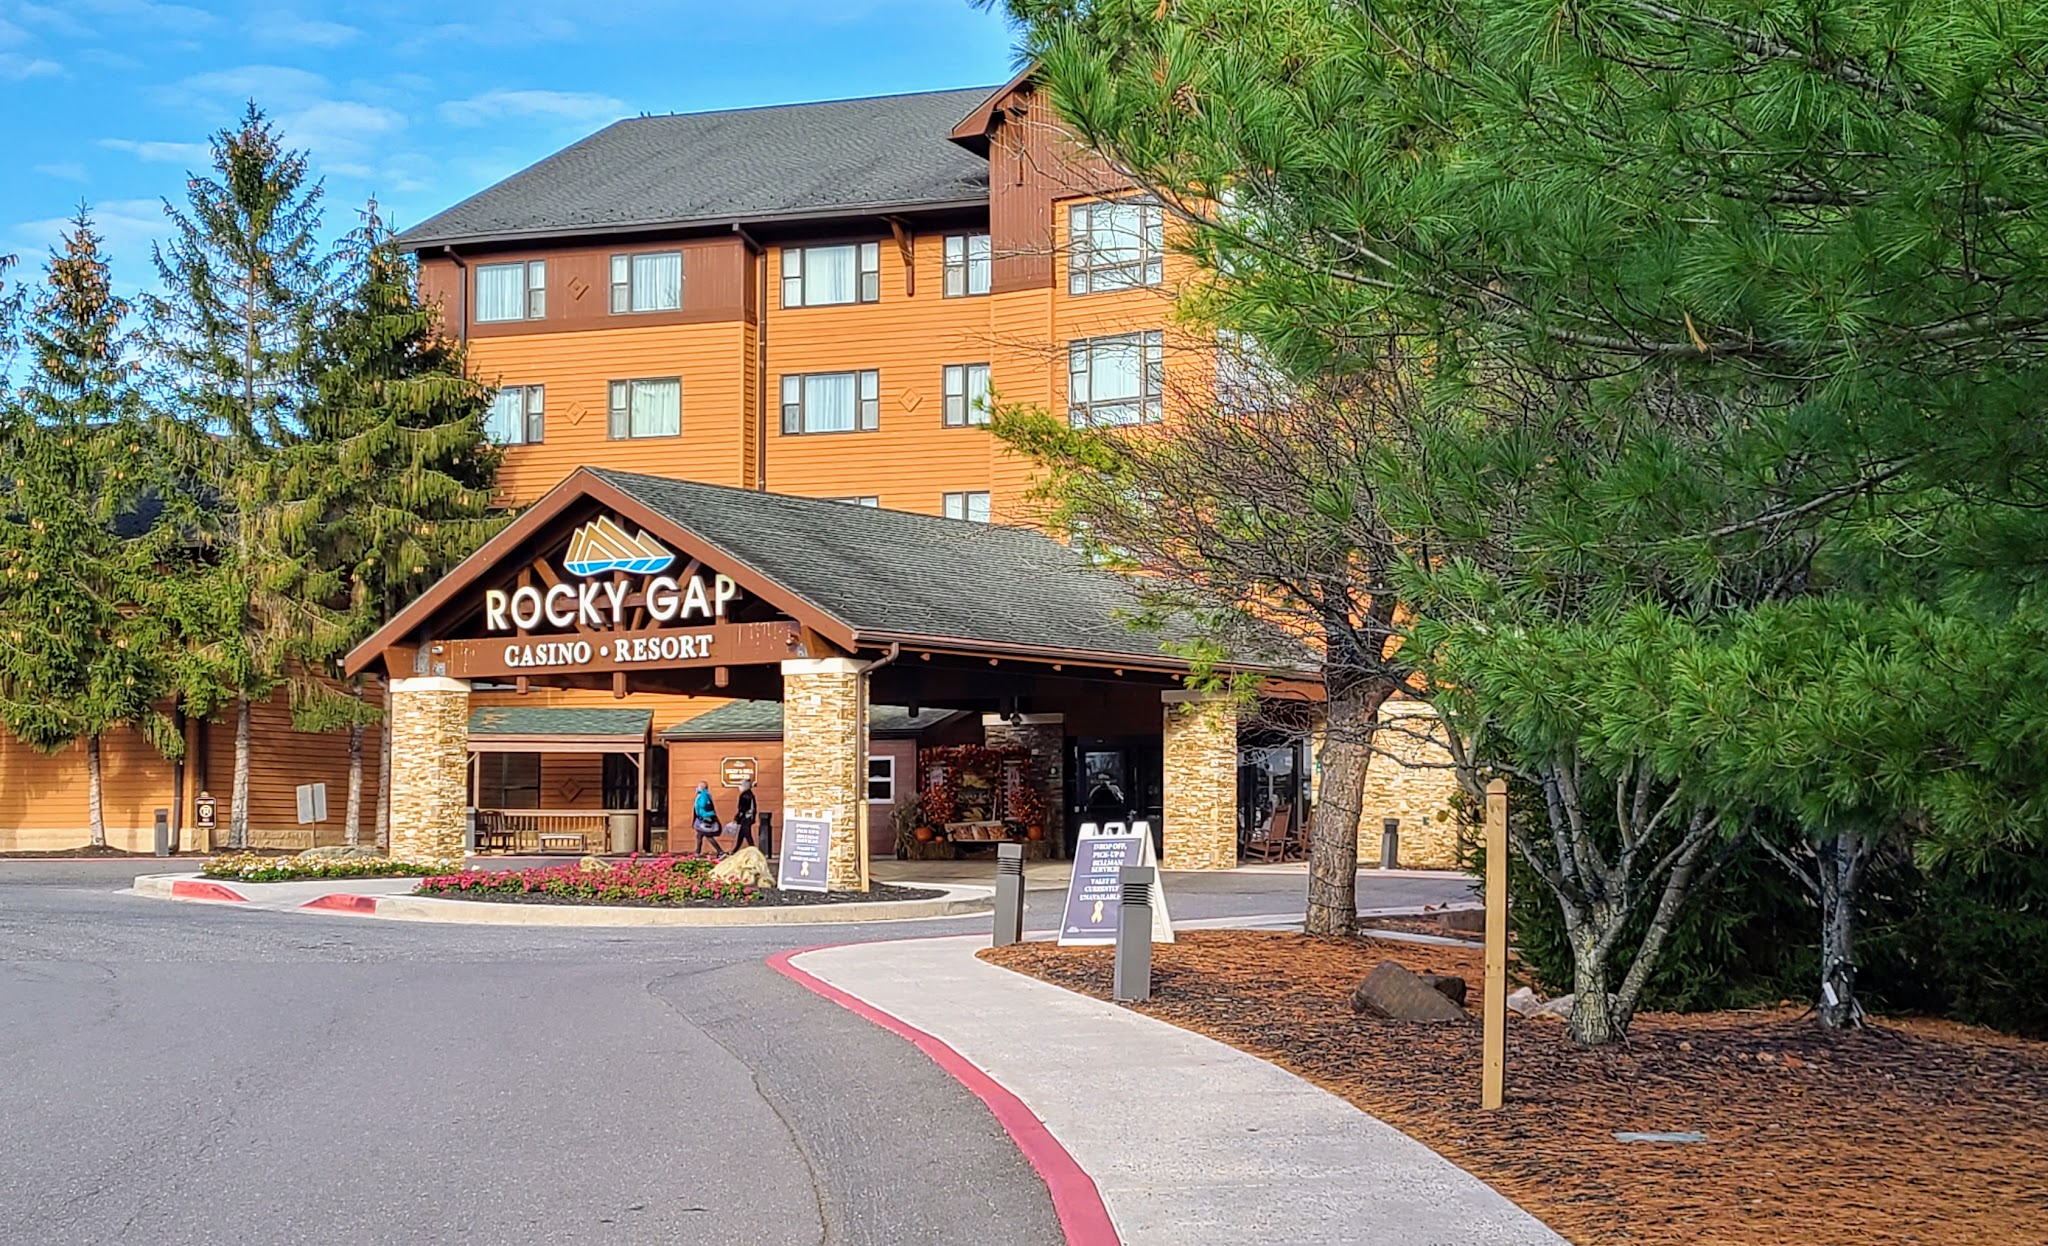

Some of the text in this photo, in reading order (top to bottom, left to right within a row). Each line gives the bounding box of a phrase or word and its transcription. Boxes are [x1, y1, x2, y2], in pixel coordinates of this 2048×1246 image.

[486, 574, 736, 631] ROCKY GAP
[504, 634, 713, 667] CASINO RESORT
